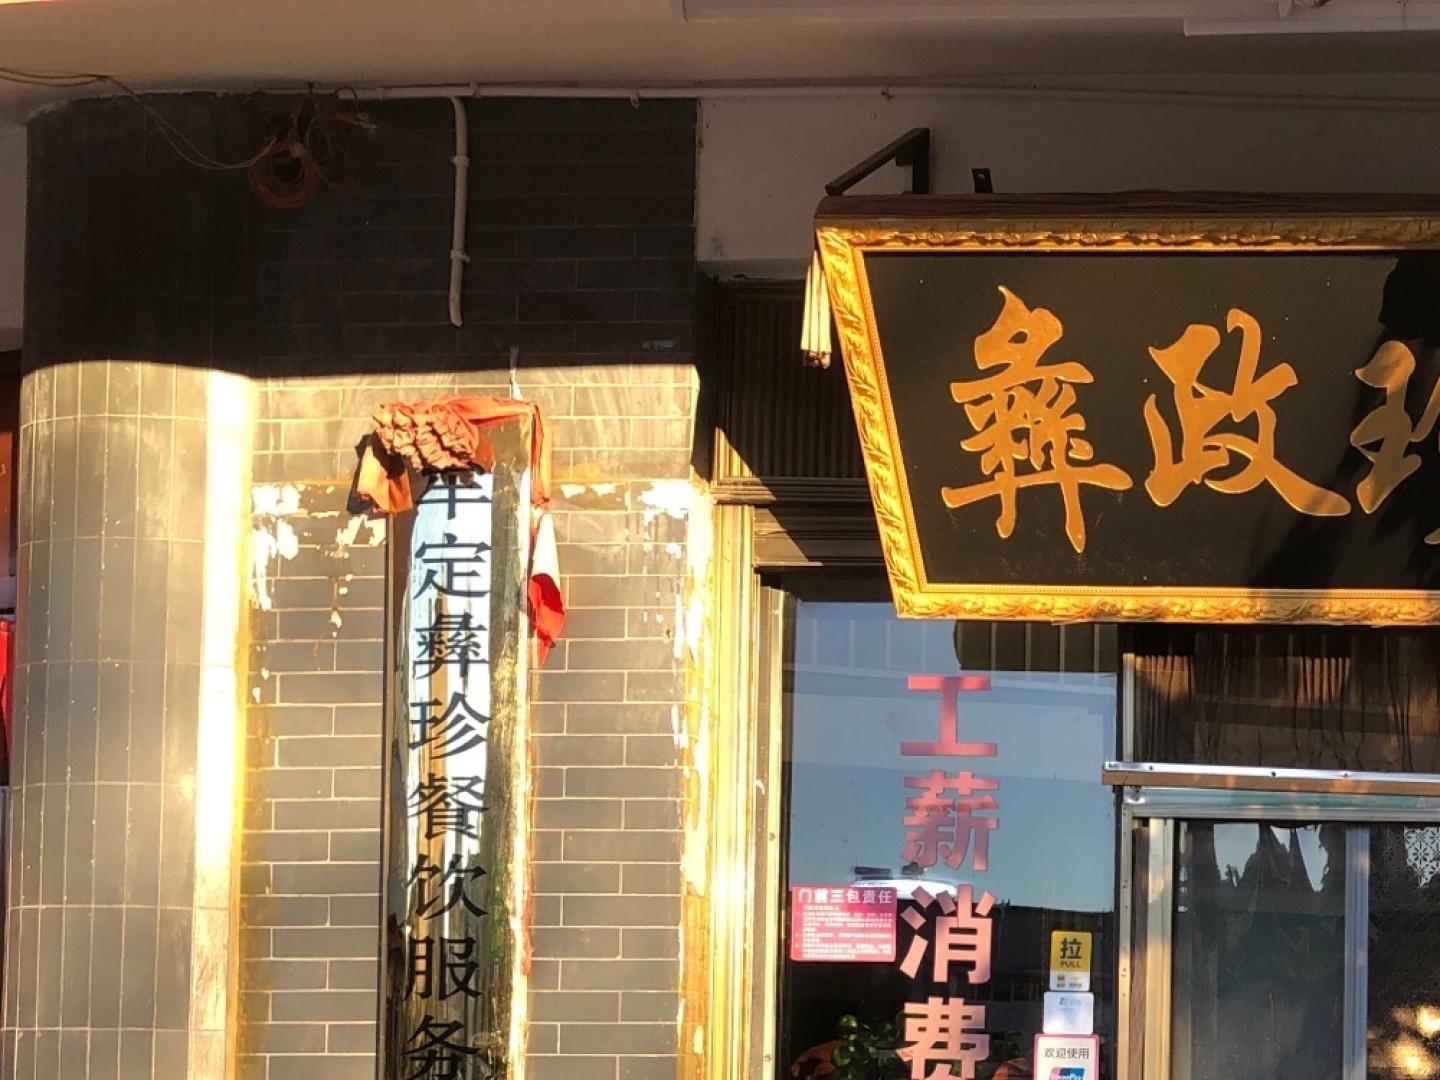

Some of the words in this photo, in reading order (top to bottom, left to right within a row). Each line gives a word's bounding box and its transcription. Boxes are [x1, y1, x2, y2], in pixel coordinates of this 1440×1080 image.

[1060, 937, 1082, 960] 拉
[1044, 1047, 1089, 1059] 欢迎使用
